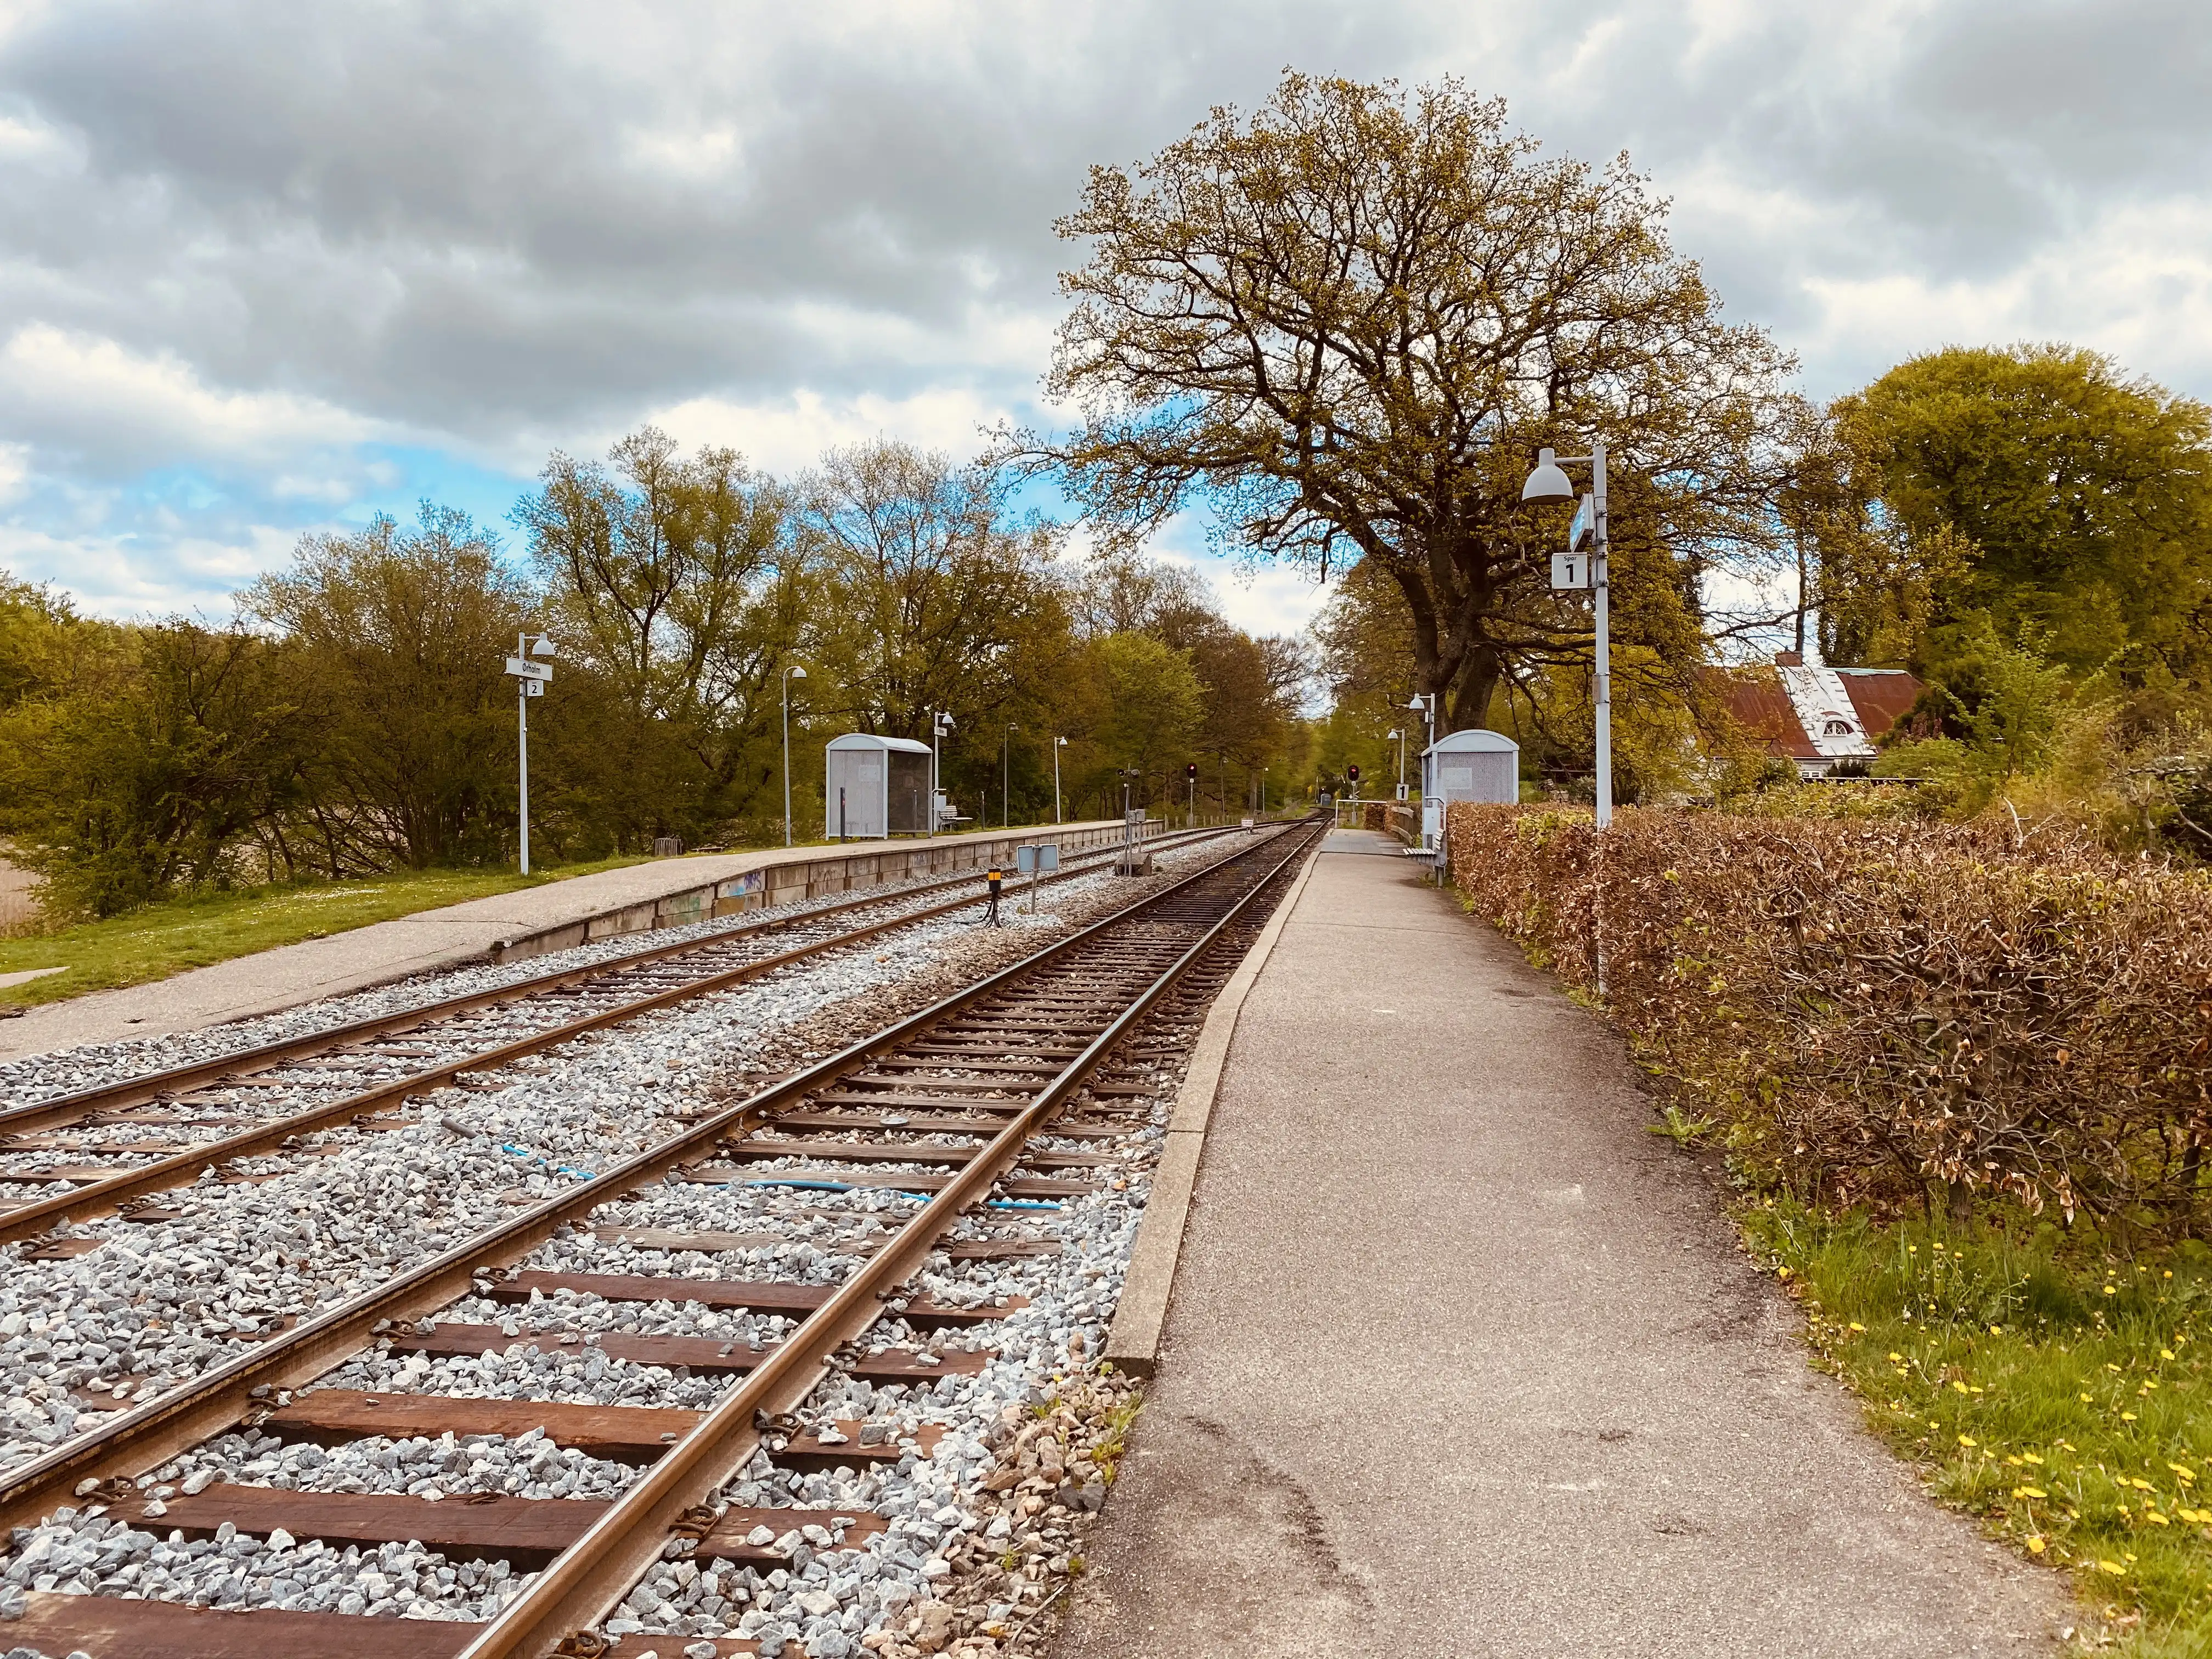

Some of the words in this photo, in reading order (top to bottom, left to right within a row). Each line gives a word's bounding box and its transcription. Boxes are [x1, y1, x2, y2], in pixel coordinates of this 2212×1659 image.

[1565, 563, 1574, 583] 1
[522, 662, 541, 674] Ørholm
[532, 685, 538, 693] 2
[1400, 786, 1405, 799] 1
